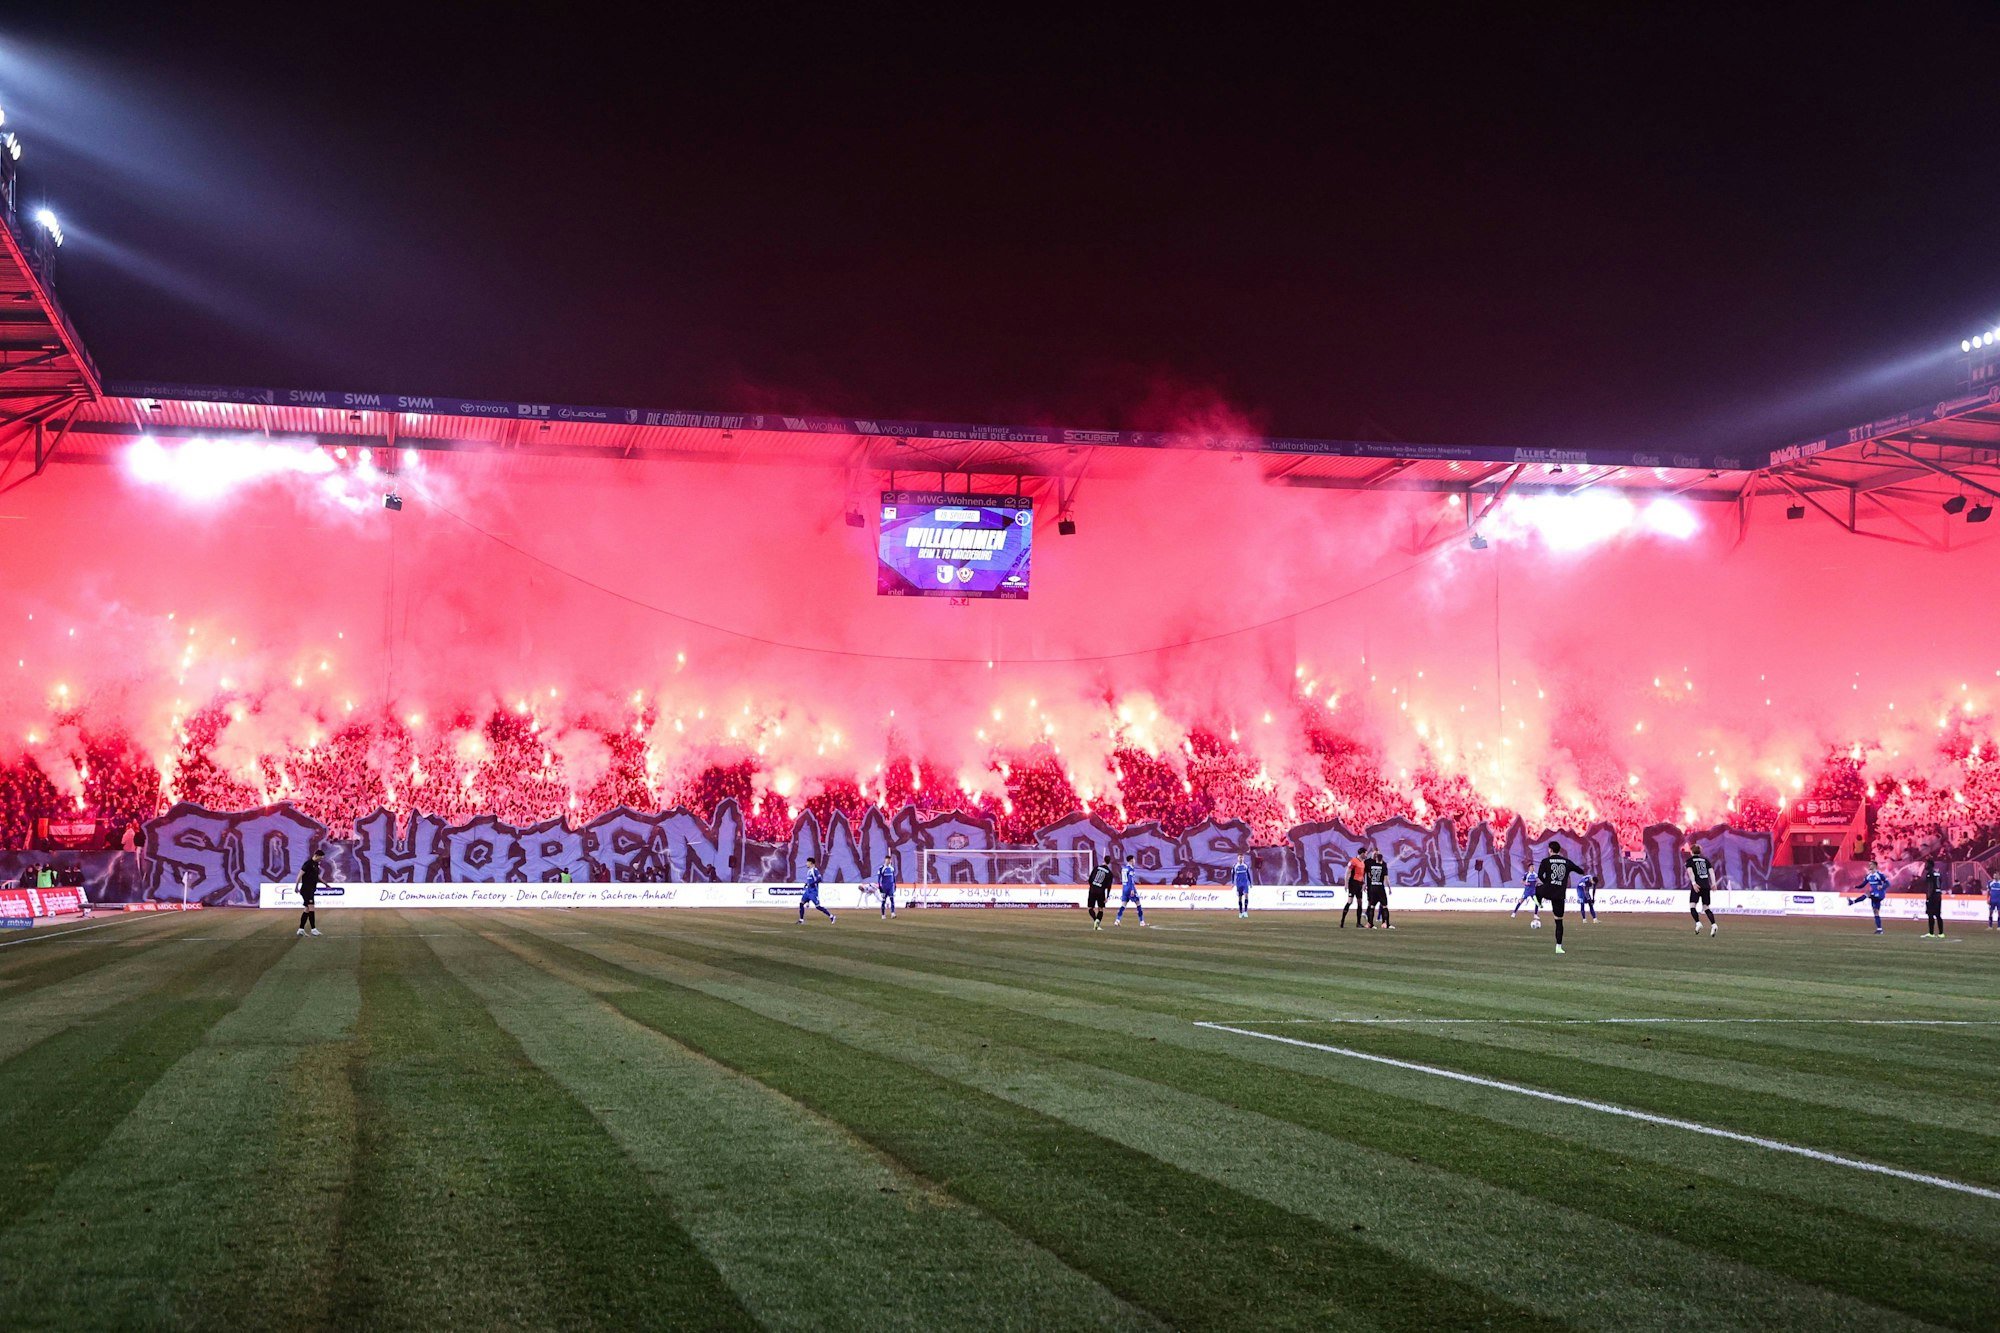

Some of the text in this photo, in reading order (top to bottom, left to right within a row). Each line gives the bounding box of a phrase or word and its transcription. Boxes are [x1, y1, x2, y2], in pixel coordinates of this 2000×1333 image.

[289, 389, 327, 403] SWM
[343, 393, 381, 406] SWM
[397, 396, 434, 409] SWM
[475, 405, 510, 414] TOYOTA
[517, 404, 551, 416] DIT
[645, 412, 661, 425] DIE
[702, 415, 720, 428] DER
[720, 416, 745, 429] WELT
[809, 422, 847, 432] WOBAU
[880, 426, 918, 435] WOBAU
[932, 430, 967, 439] BADEN
[969, 431, 988, 440] WIE
[990, 432, 1007, 441] DIE
[1063, 430, 1120, 442] SCHUBERT
[917, 495, 998, 507] MWG-Wohnen.de
[905, 527, 1008, 551] WILLKOMMEN
[140, 799, 330, 908] SO
[1550, 863, 1567, 881] 39
[379, 889, 397, 902] Die
[398, 890, 469, 902] Communication
[471, 890, 507, 903] Factory
[516, 889, 539, 902] Dein
[540, 889, 586, 901] Callcenter
[588, 889, 598, 900] in
[600, 889, 679, 901] Sachsen-Anhalt!
[1151, 892, 1163, 901] als
[1164, 893, 1177, 901] ein
[1178, 892, 1220, 902] Callcenter
[1424, 893, 1438, 905] Die
[1439, 893, 1498, 904] Communication
[1609, 895, 1675, 906] Sachsen-Anhalt!
